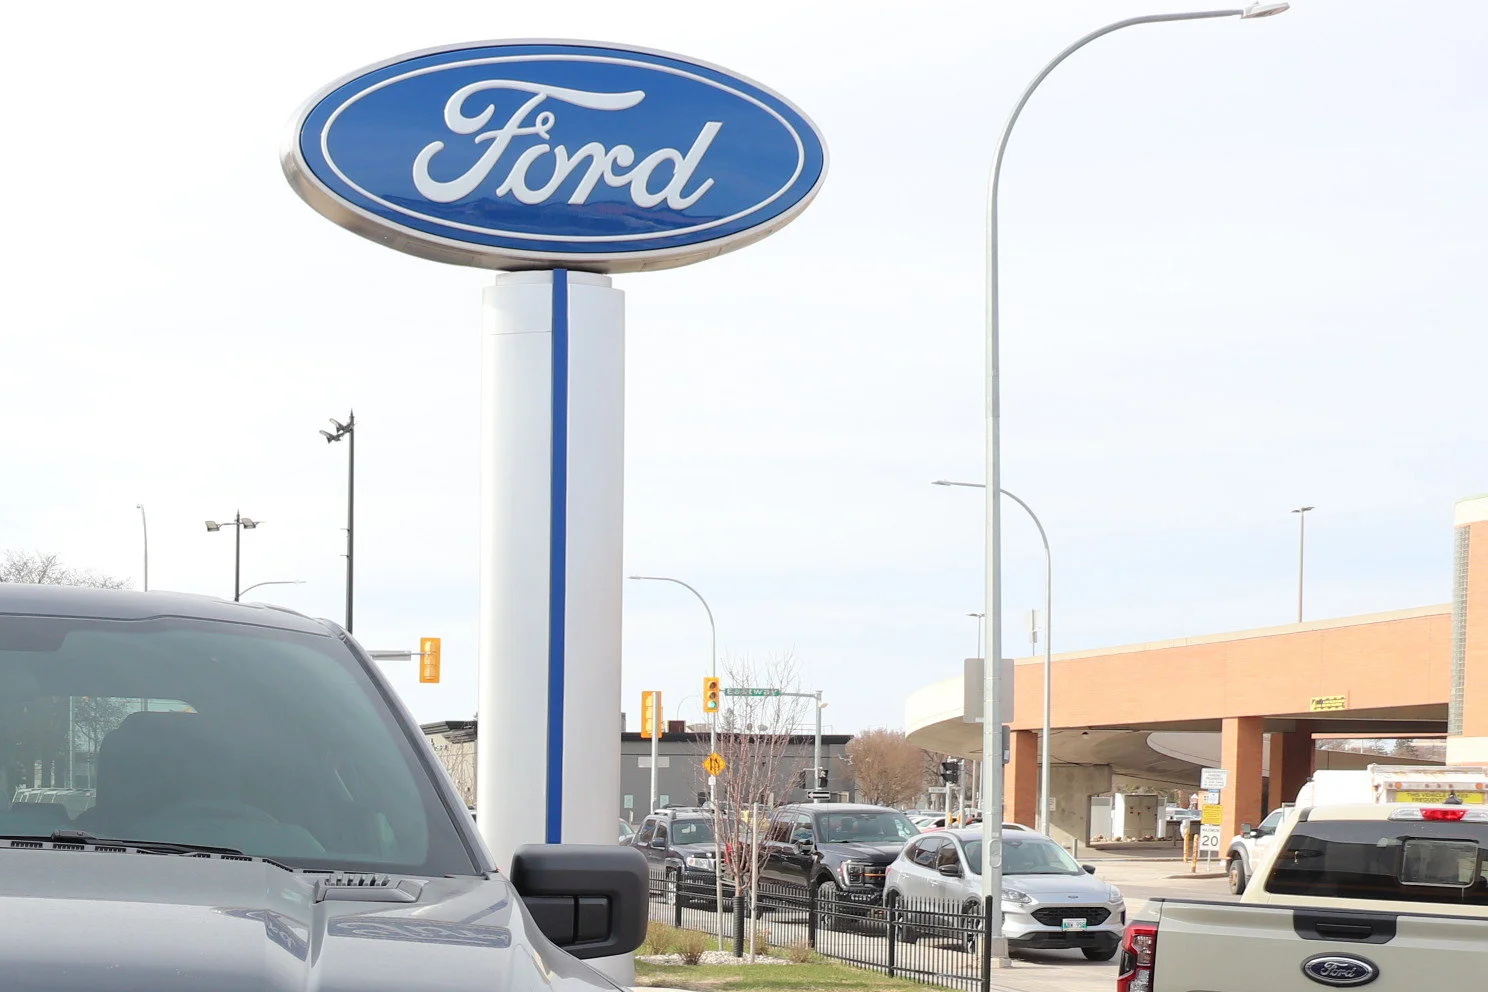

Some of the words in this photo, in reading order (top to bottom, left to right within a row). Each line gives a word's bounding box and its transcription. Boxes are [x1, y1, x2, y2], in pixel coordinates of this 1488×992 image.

[412, 78, 723, 211] Ford
[1201, 835, 1219, 847] 20
[1319, 961, 1357, 978] Ford
